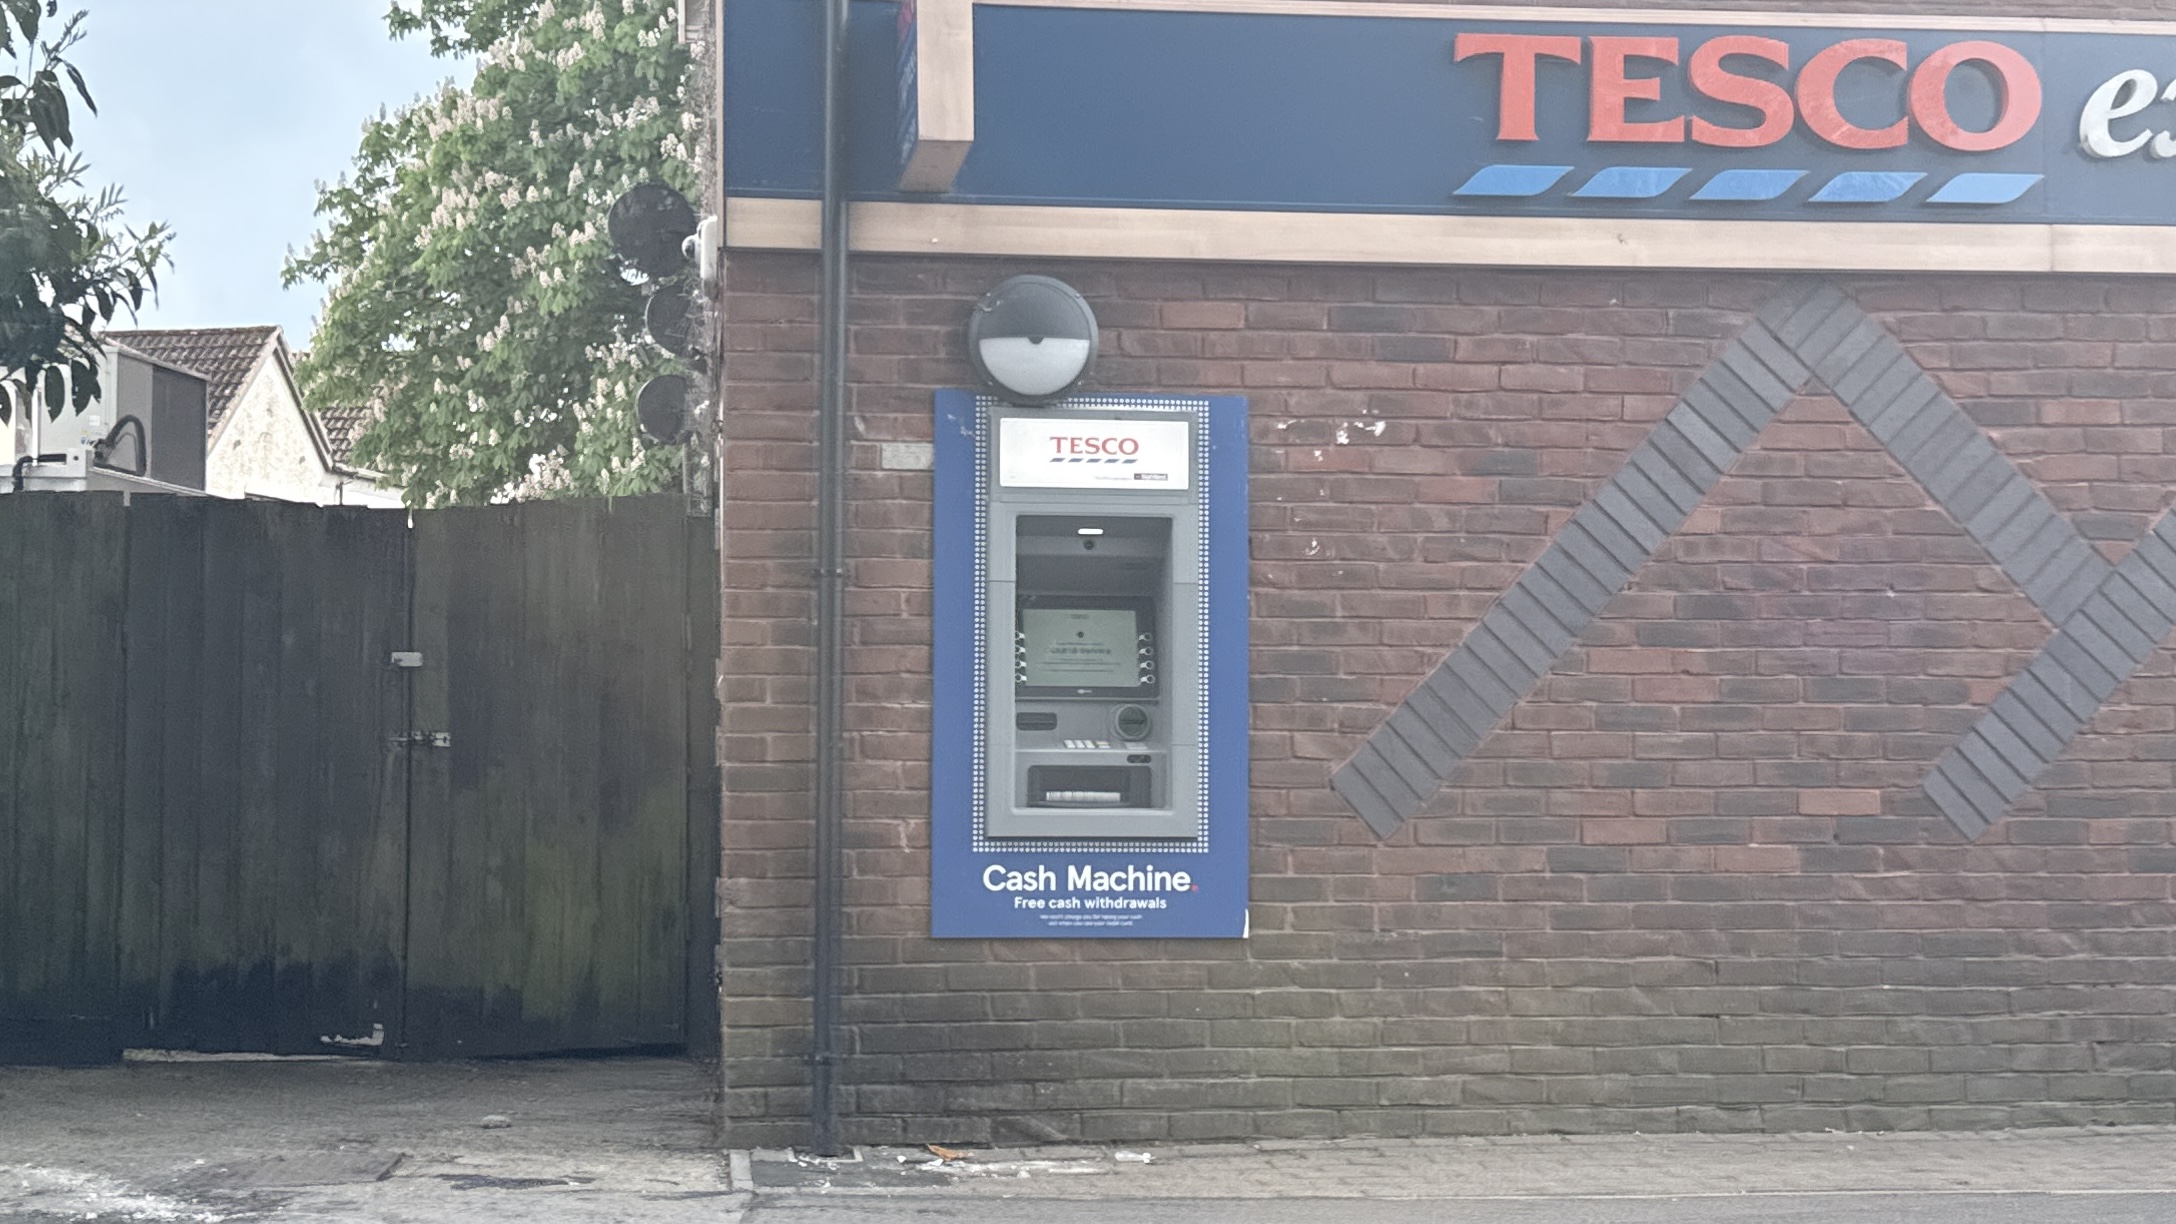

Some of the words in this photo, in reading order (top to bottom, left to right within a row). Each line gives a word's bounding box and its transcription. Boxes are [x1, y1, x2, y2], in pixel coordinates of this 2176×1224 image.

[1454, 32, 2043, 152] TESCO
[2079, 69, 2176, 158] e
[1049, 436, 1140, 455] TESCO
[982, 864, 1057, 891] Cash
[1014, 896, 1046, 909] Free
[1048, 896, 1081, 909] cash
[1084, 896, 1167, 909] withdrawals
